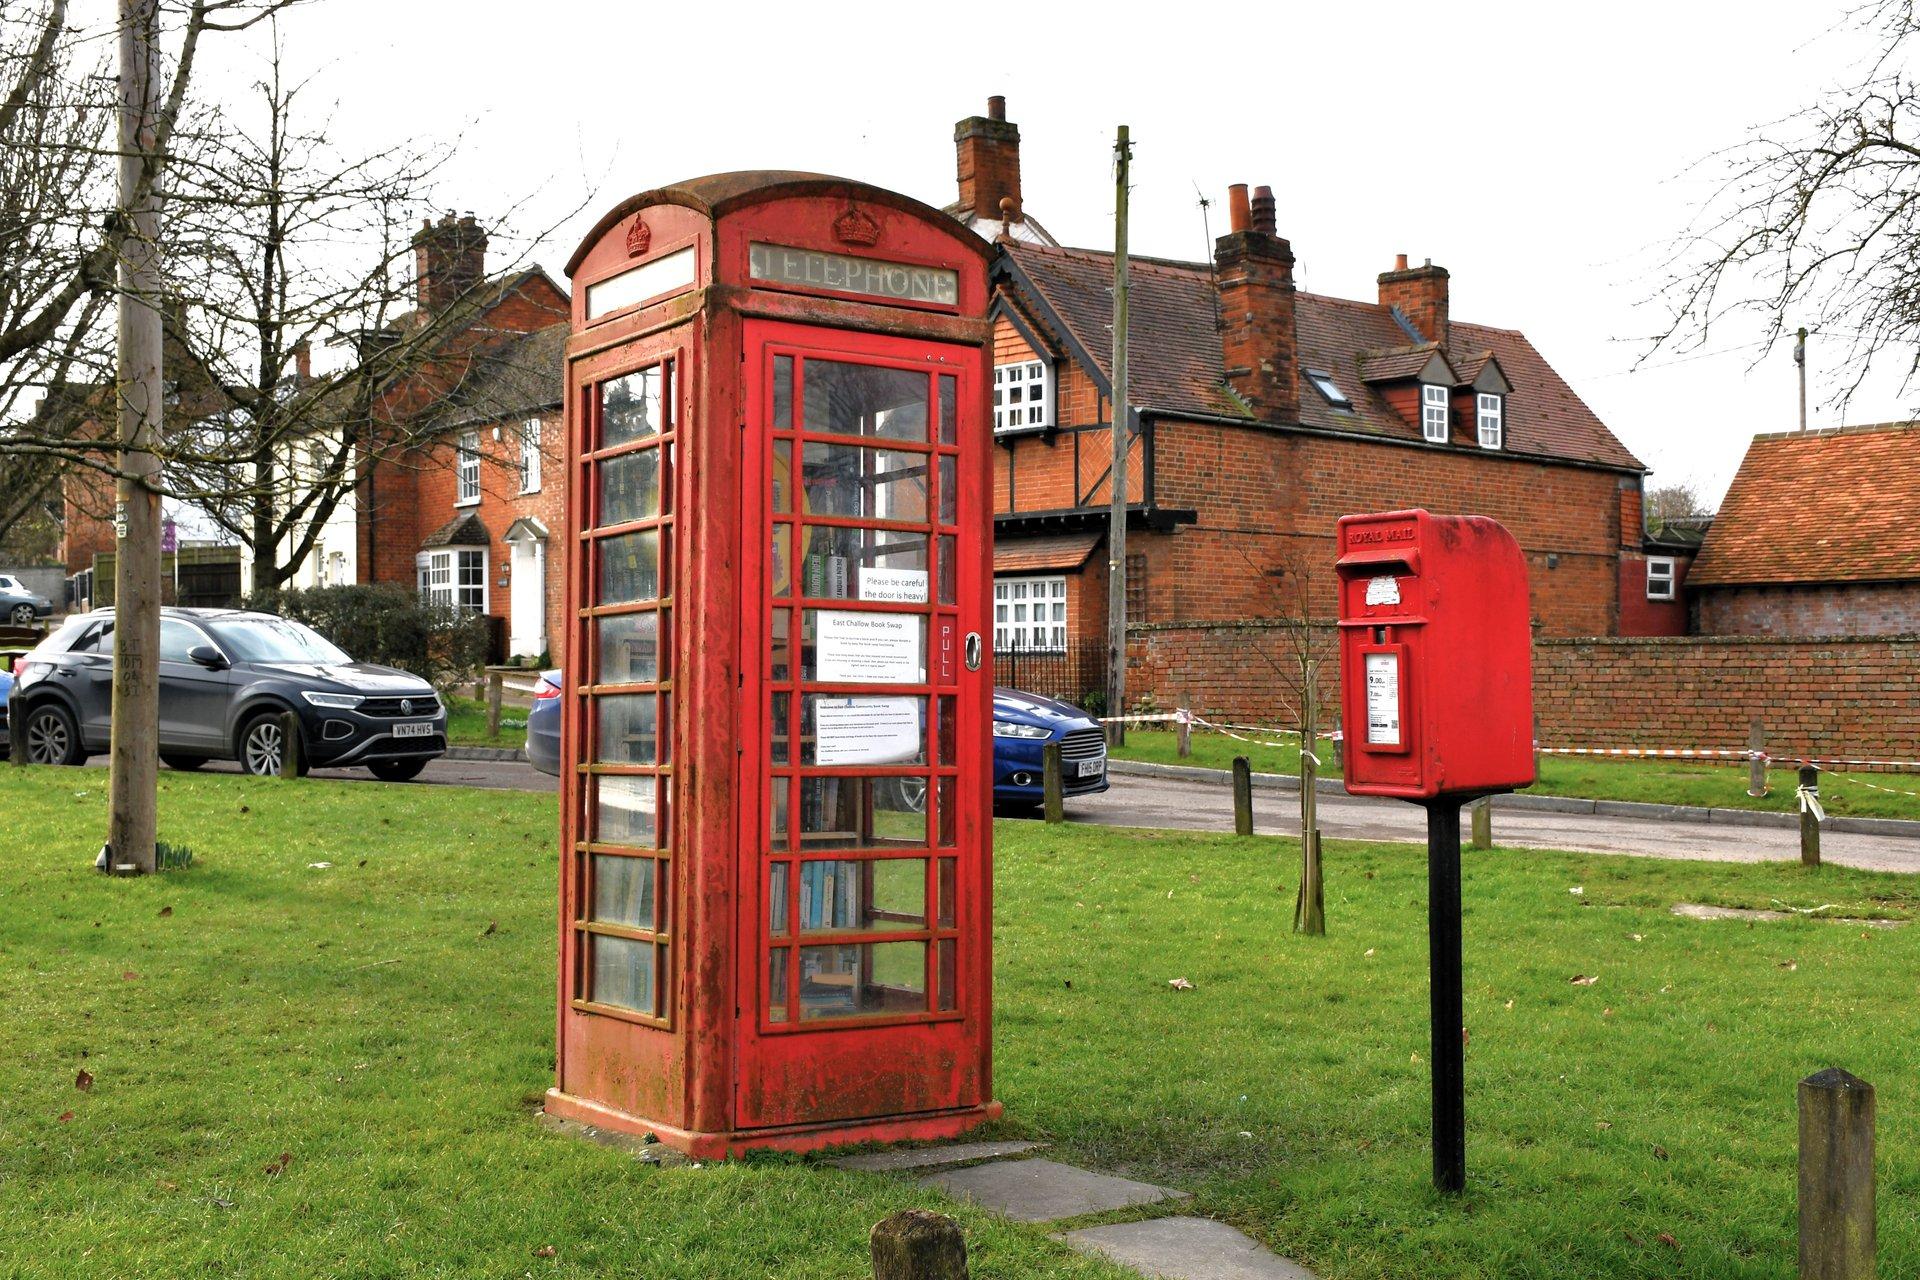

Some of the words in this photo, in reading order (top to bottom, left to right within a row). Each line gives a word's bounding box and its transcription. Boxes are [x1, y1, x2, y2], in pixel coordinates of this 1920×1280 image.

[759, 246, 952, 300] TELEPHONE
[1349, 531, 1383, 544] ROYAL
[1386, 528, 1415, 541] MAIL
[866, 577, 889, 586] Please
[891, 577, 900, 586] be
[901, 579, 925, 588] careful
[865, 591, 876, 599] the
[878, 591, 894, 599] door
[896, 591, 902, 599] is
[903, 591, 926, 601] heavy!
[832, 619, 845, 627] East
[847, 620, 869, 628] Challow
[887, 622, 903, 630] Swap
[942, 626, 950, 677] PULL
[397, 725, 415, 736] VN74
[416, 724, 431, 735] HVS
